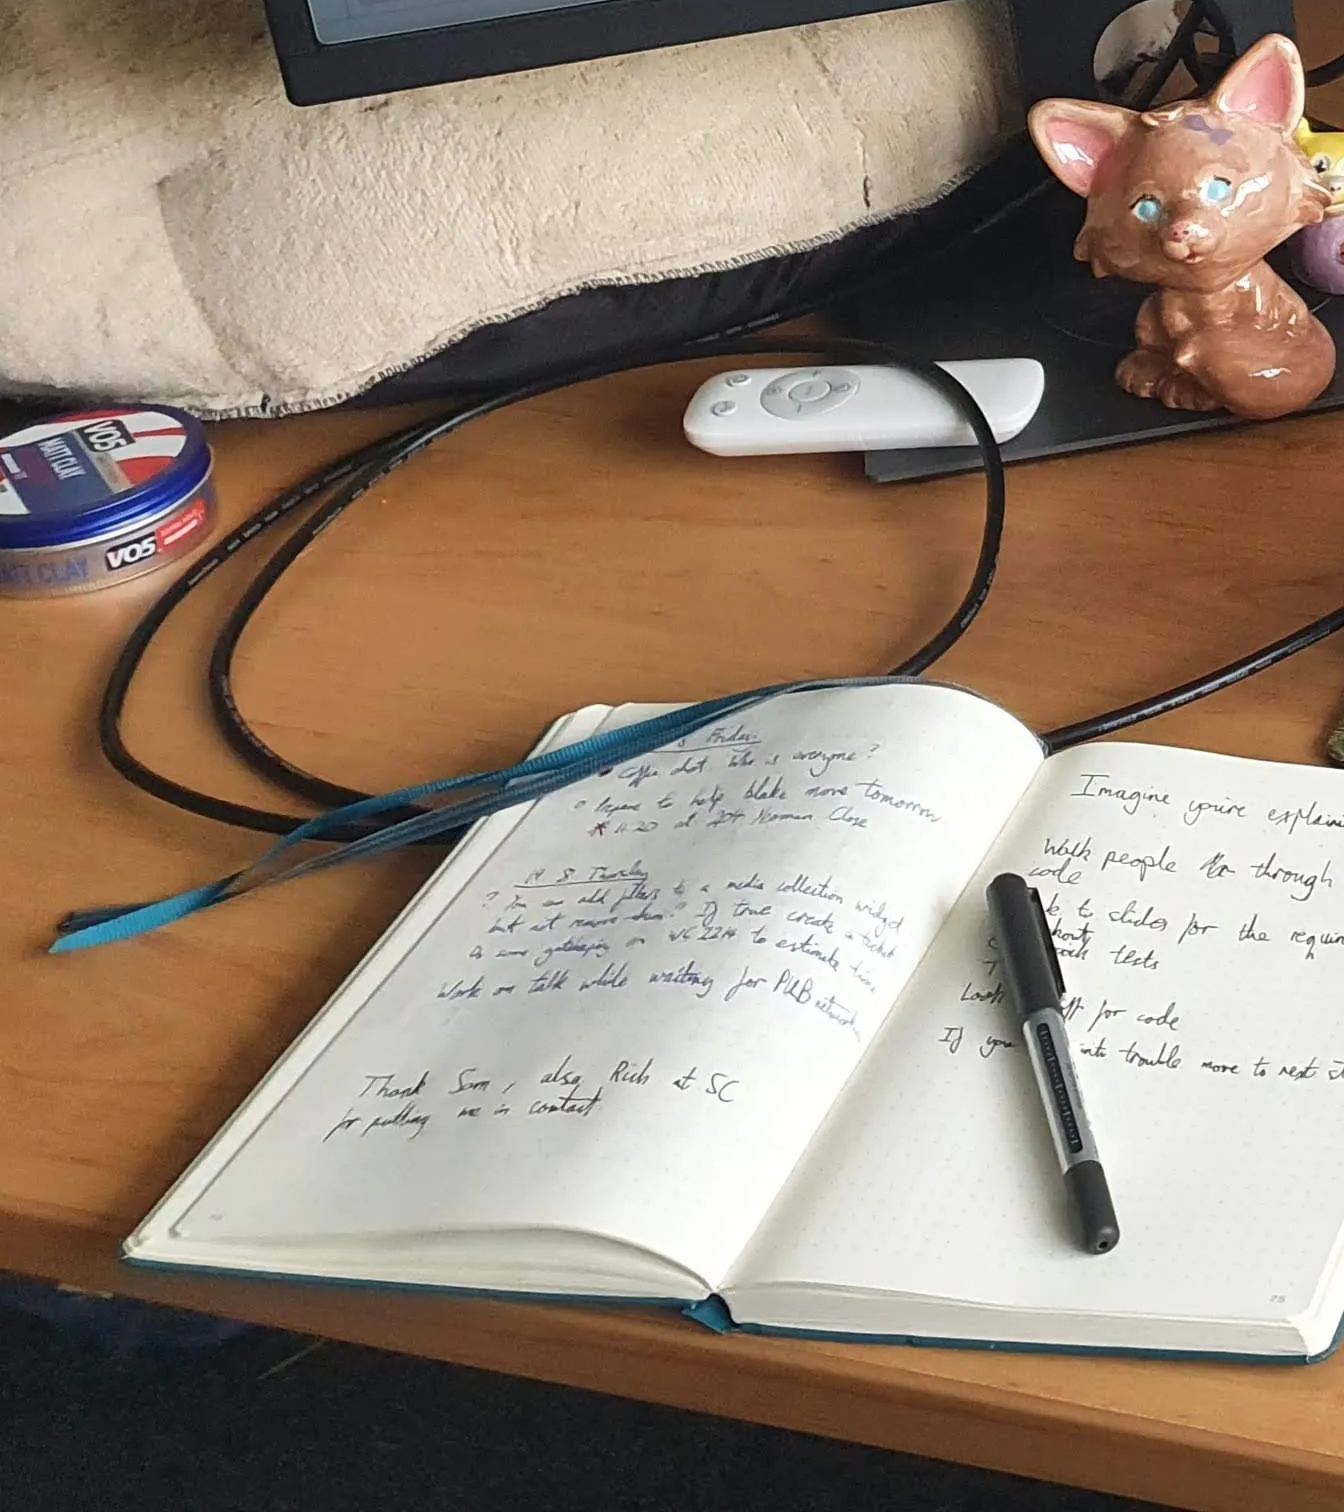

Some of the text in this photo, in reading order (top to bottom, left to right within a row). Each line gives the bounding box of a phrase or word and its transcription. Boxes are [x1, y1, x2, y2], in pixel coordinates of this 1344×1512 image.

[84, 421, 127, 451] VO5
[106, 538, 157, 569] VO5
[1071, 773, 1171, 816] Imagine
[1029, 865, 1083, 887] code
[1044, 837, 1093, 863] Walk
[1102, 847, 1178, 888] people
[1251, 859, 1334, 902] through
[1077, 896, 1096, 920] to
[1178, 912, 1219, 944] for
[1238, 922, 1272, 945] the
[1113, 947, 1161, 971] tests
[1095, 1001, 1182, 1031] for code
[938, 1025, 965, 1054] If
[1119, 1043, 1183, 1071] trouble
[1253, 1056, 1269, 1079] to
[359, 1070, 431, 1099] Thank
[610, 1058, 654, 1086] Rich
[529, 1086, 603, 1118] contact
